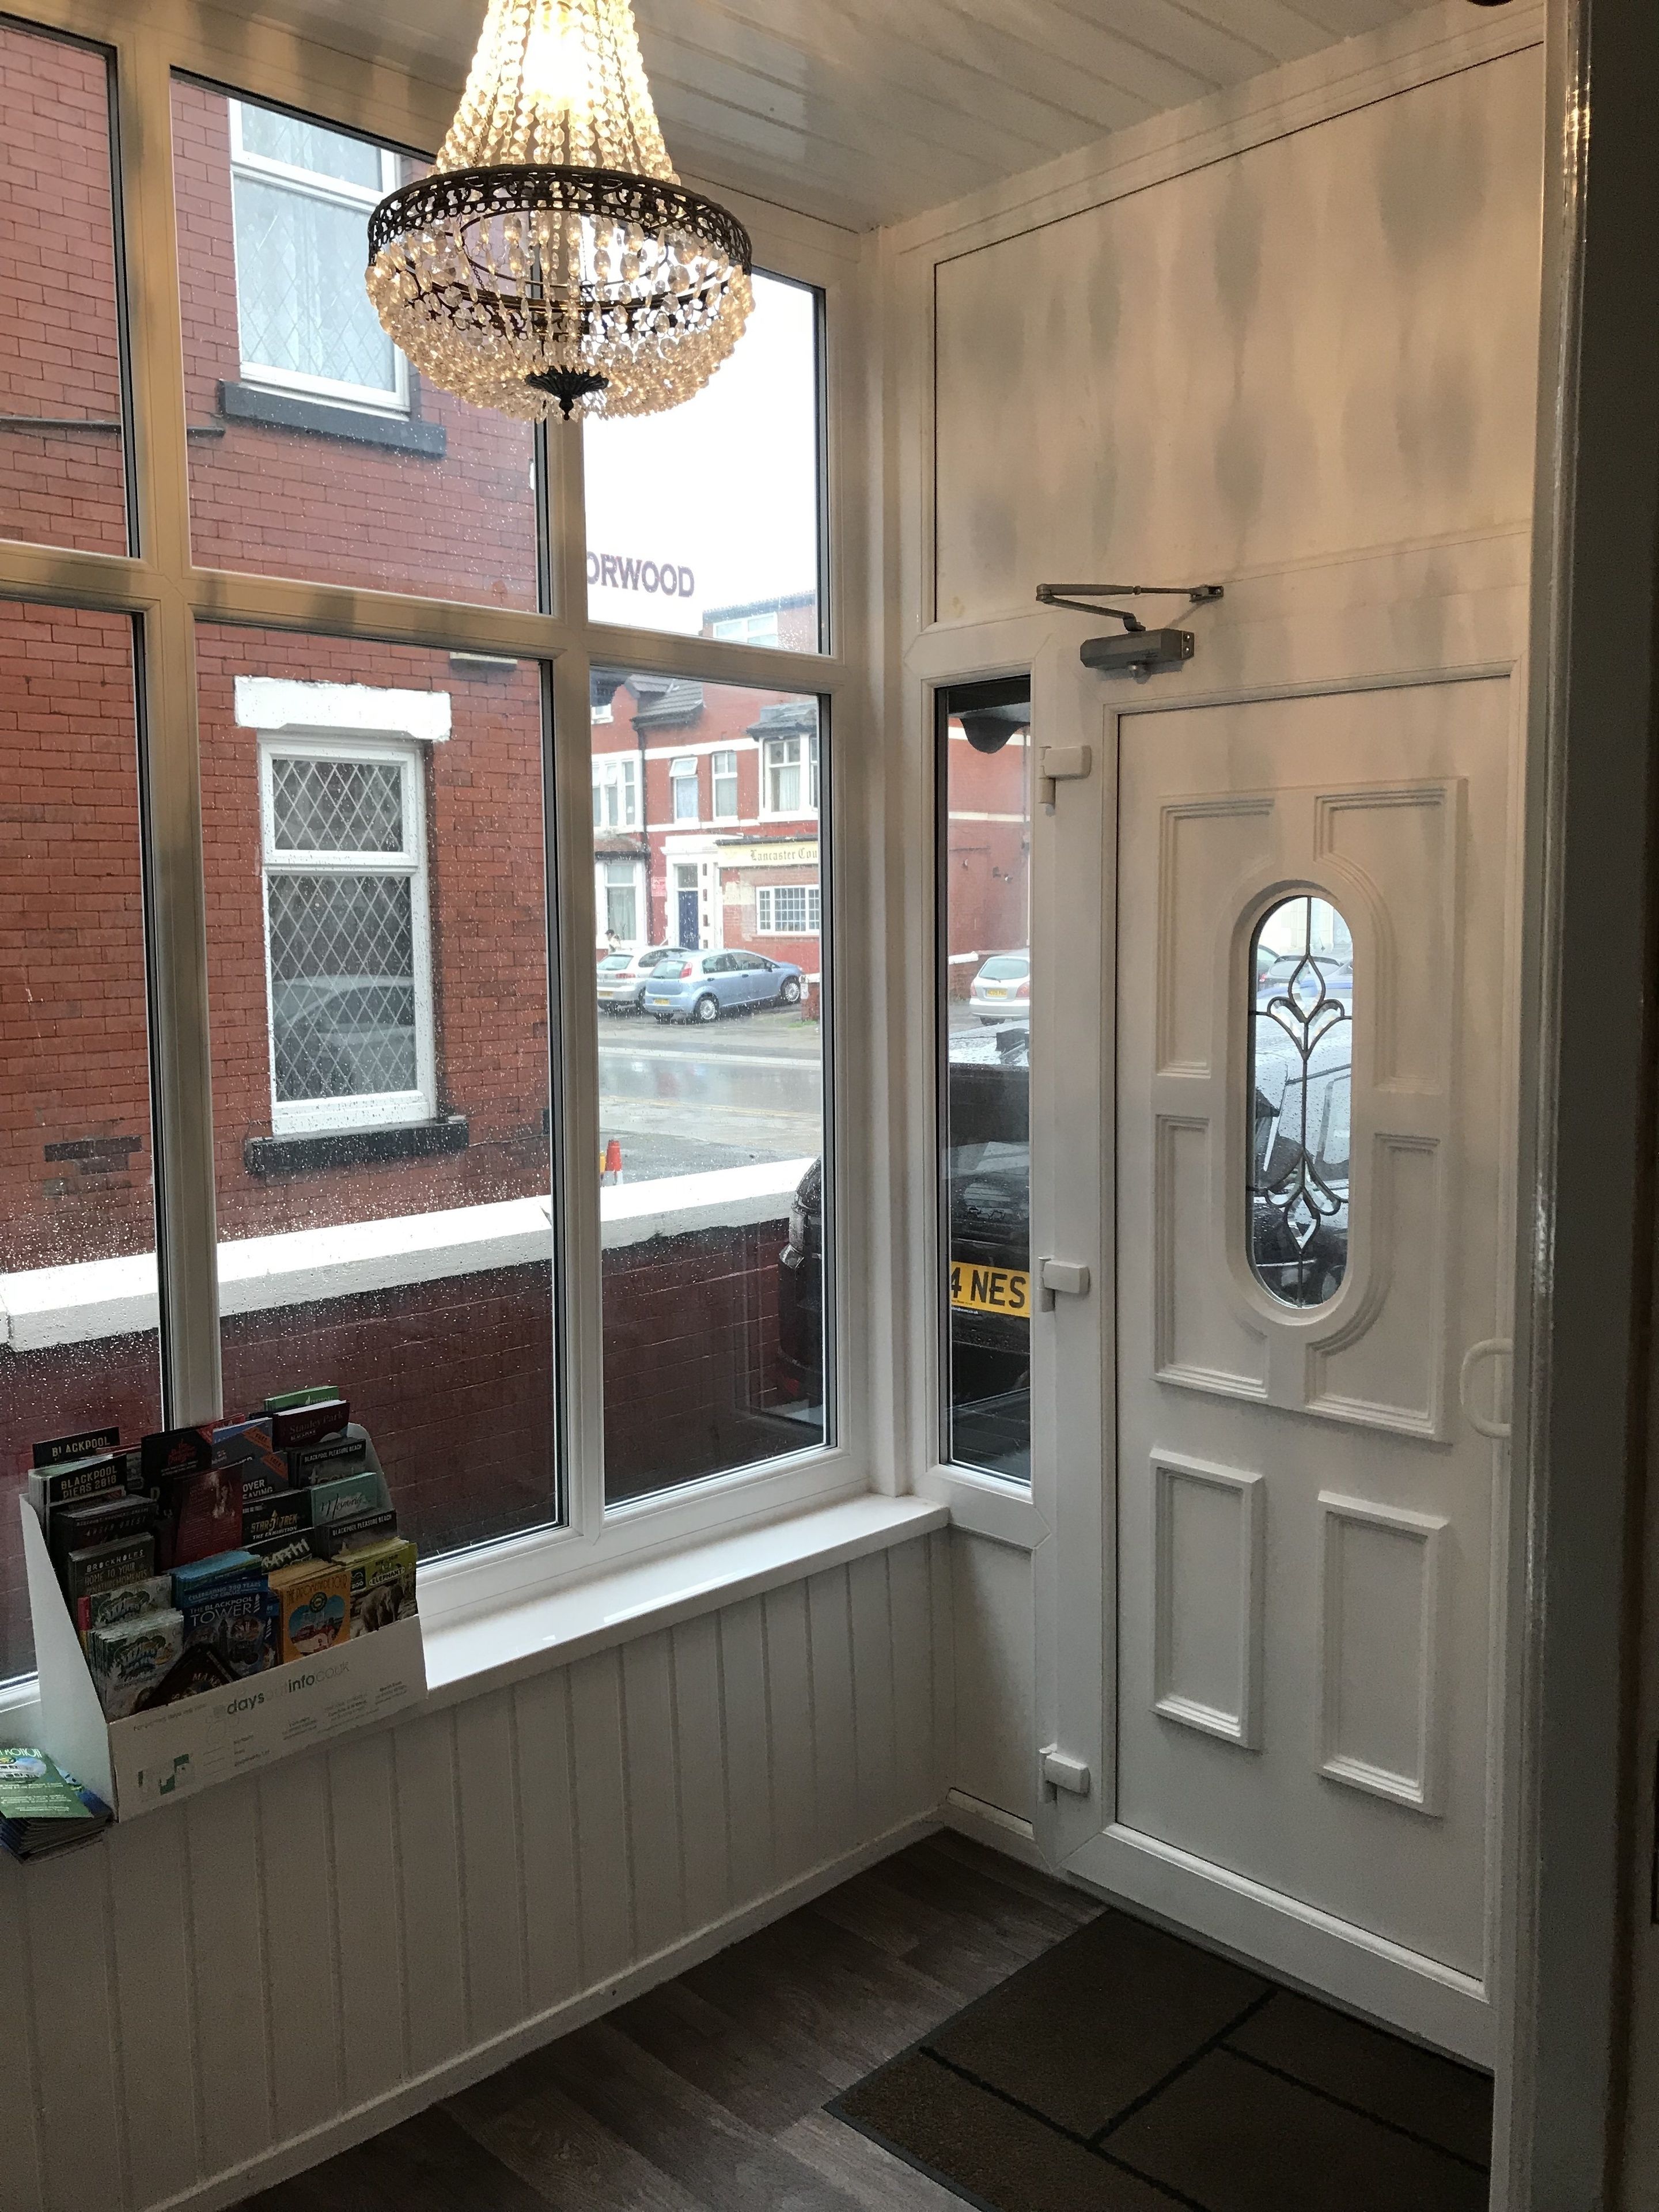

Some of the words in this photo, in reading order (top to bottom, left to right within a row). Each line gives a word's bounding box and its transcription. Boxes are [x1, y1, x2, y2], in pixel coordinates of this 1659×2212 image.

[750, 849, 796, 861] Lancaster
[971, 1270, 1027, 1309] NES
[290, 1419, 321, 1435] Stanley
[323, 1411, 343, 1424] Park
[52, 1435, 111, 1457] BLACKPOOL
[304, 1452, 328, 1463] BLACKPOOL
[328, 1448, 349, 1458] PLEASURE
[349, 1444, 362, 1453] BEACH
[61, 1465, 118, 1490] BLACKPOOL
[94, 1475, 117, 1490] 2018
[243, 1479, 266, 1493] OVER
[251, 1520, 270, 1533] STAR
[265, 1525, 298, 1539] EXHIBITION
[332, 1525, 357, 1536] BLACKPOOL
[357, 1517, 378, 1530] PLEASURE
[378, 1513, 392, 1523] BEACH
[86, 1549, 143, 1573] BROCKHOLES
[85, 1571, 104, 1586] HOME
[108, 1568, 115, 1578] TO
[119, 1562, 136, 1577] YOUR
[372, 1567, 403, 1585] ELEPHANT
[188, 1586, 227, 1601] CELEBRATING
[243, 1582, 261, 1590] YEARS
[190, 1606, 204, 1614] THE
[204, 1596, 253, 1611] BLACKPOOL
[190, 1603, 253, 1627] TOWER
